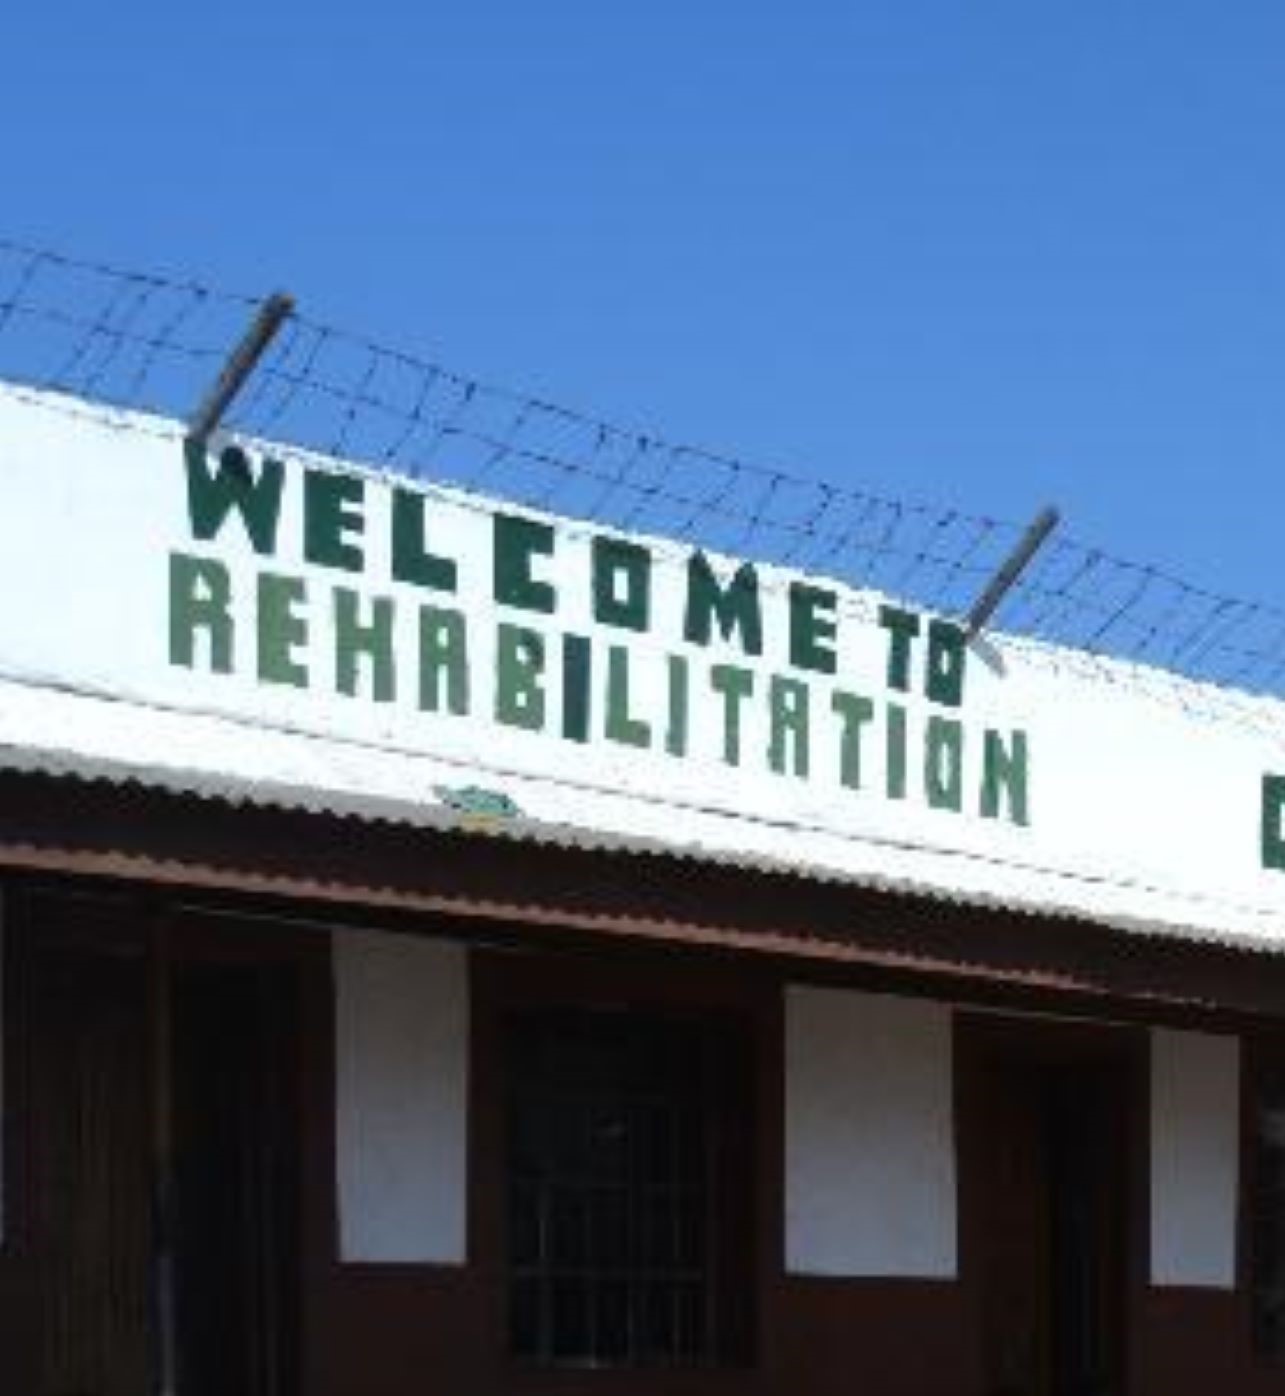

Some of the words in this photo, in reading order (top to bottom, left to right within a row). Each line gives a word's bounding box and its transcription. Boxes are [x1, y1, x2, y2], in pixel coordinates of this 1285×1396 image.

[169, 552, 1029, 827] REHABILITATION
[183, 435, 837, 673] WELCOME
[880, 604, 967, 706] TO
